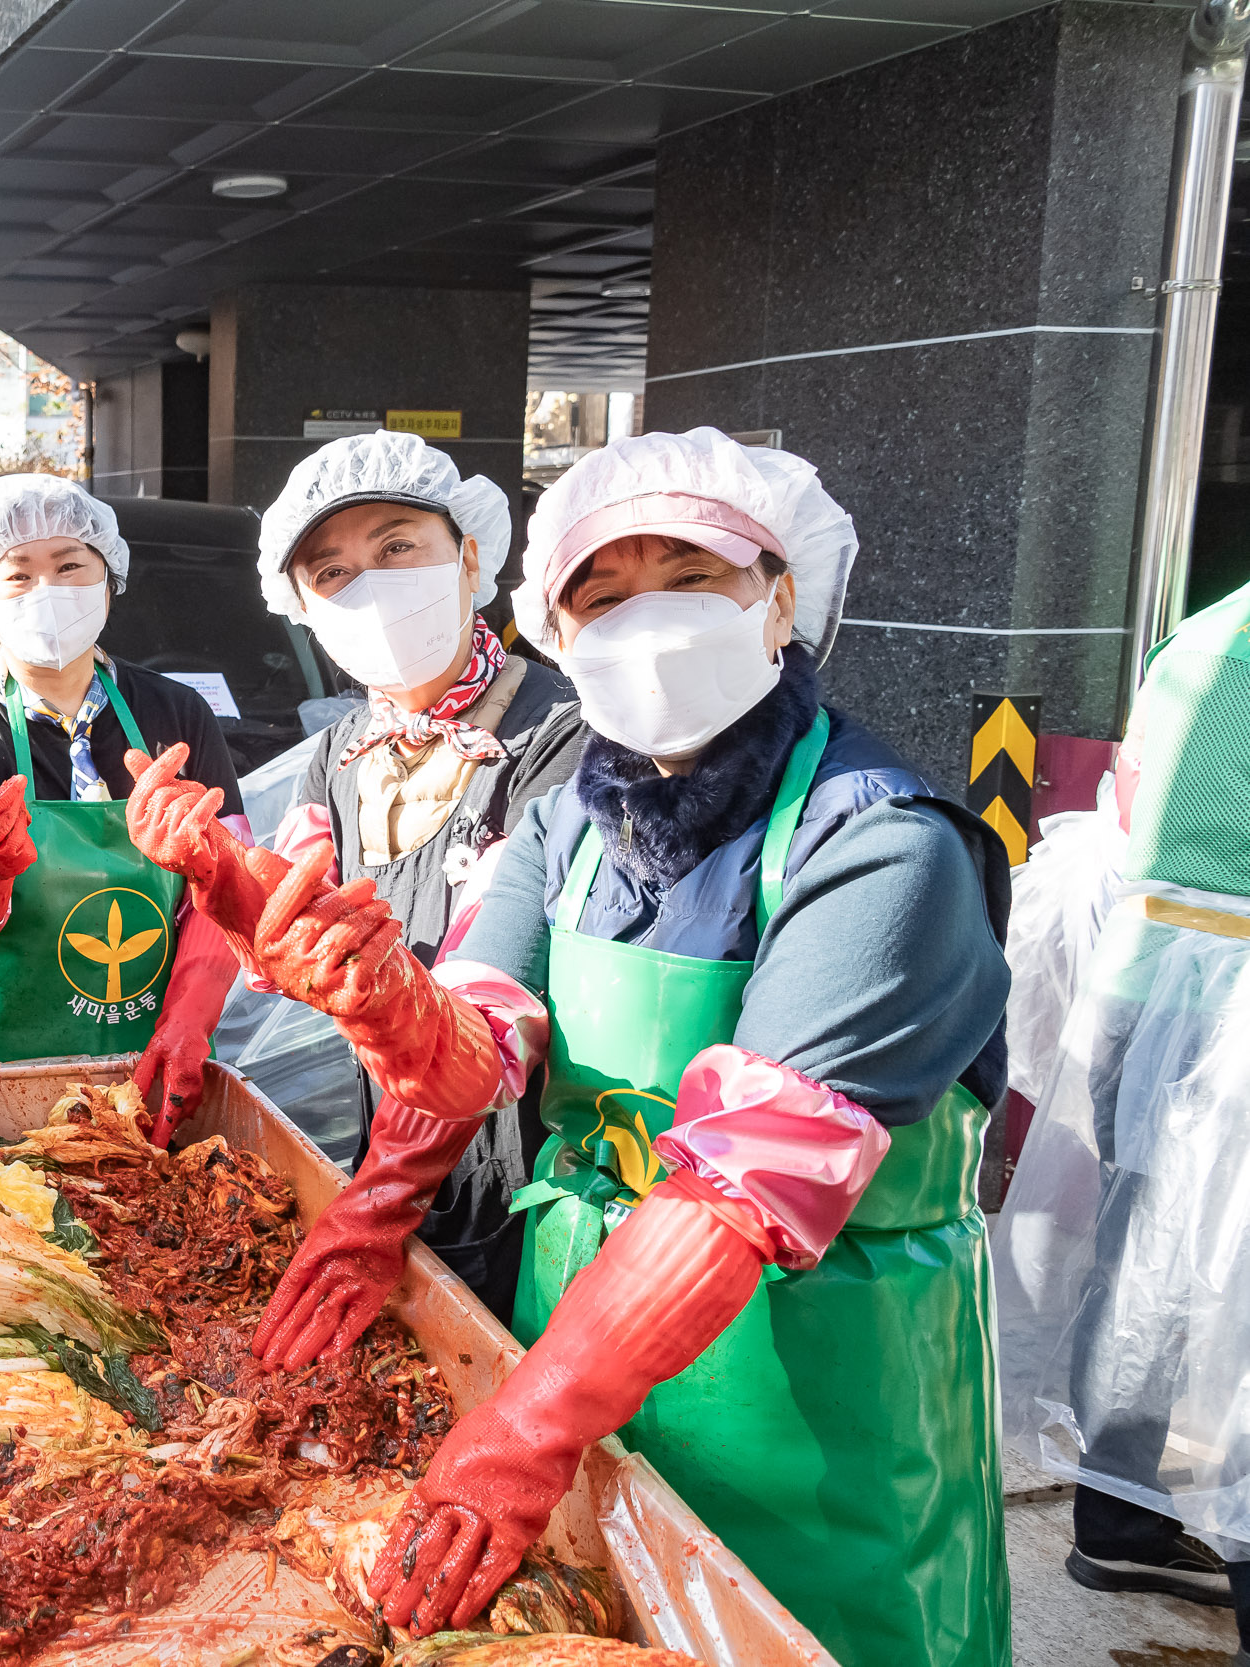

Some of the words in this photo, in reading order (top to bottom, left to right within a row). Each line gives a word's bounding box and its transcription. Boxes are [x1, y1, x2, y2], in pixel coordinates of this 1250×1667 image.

[326, 409, 353, 419] CCTV
[426, 632, 445, 648] KF-94
[67, 991, 156, 1024] 새마을운동
